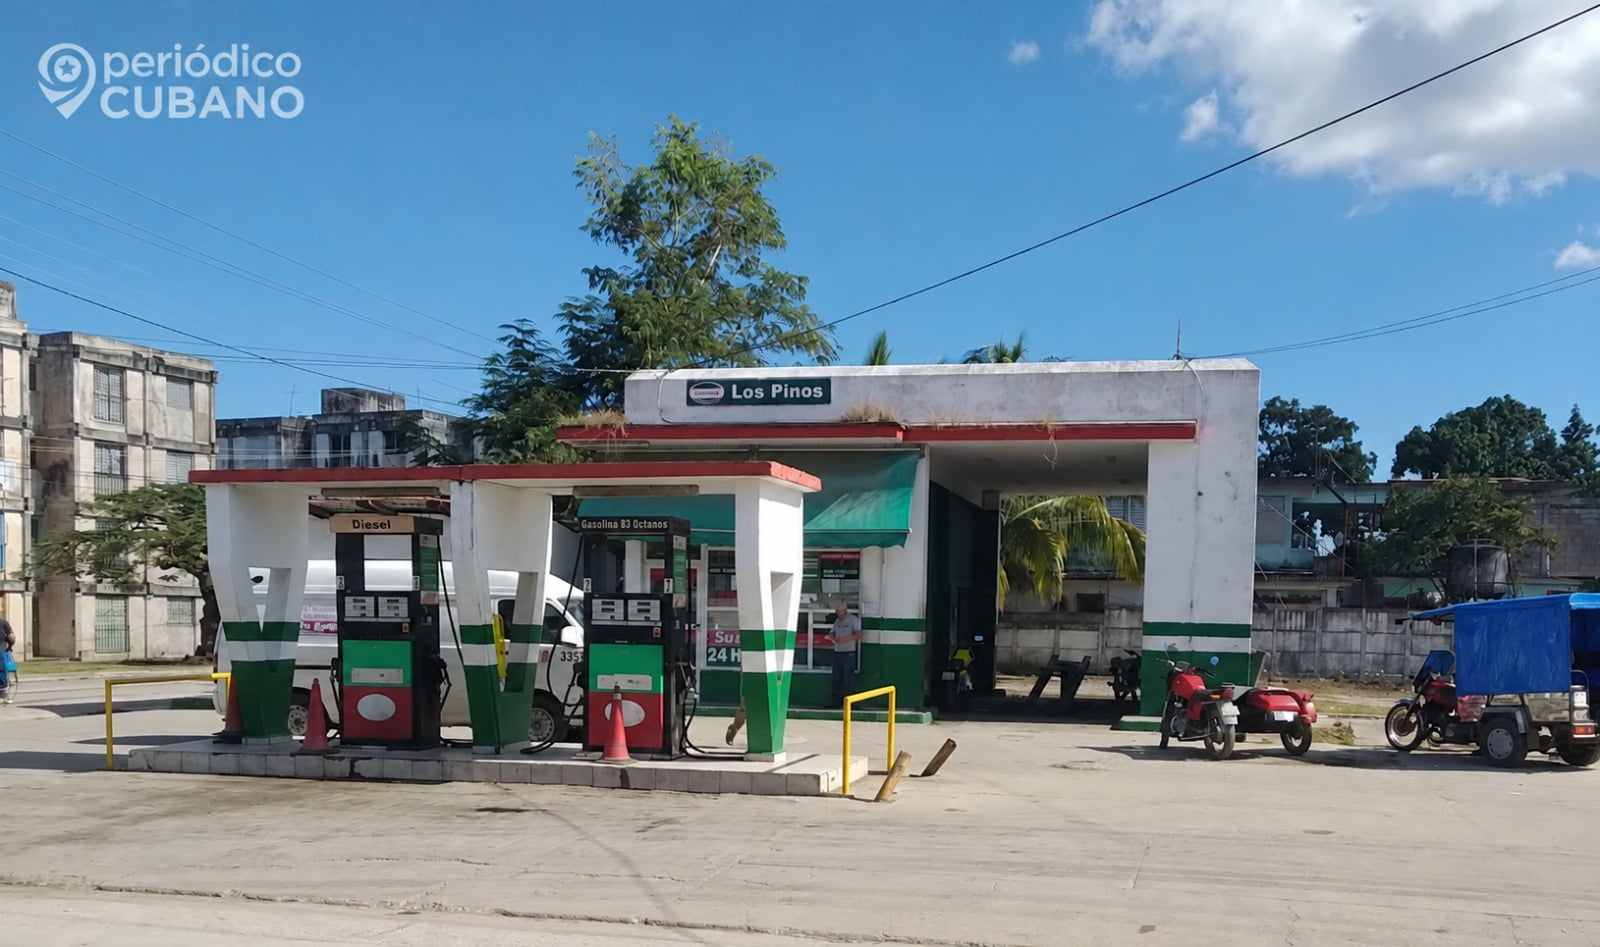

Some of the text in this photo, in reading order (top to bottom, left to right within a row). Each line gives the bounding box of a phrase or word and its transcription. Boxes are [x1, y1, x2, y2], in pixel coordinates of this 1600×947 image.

[731, 384, 764, 399] Los
[771, 384, 823, 398] Pinos
[352, 519, 391, 529] Diesel
[581, 519, 619, 529] Gasolina
[632, 519, 669, 529] Octanos
[707, 647, 728, 662] 24
